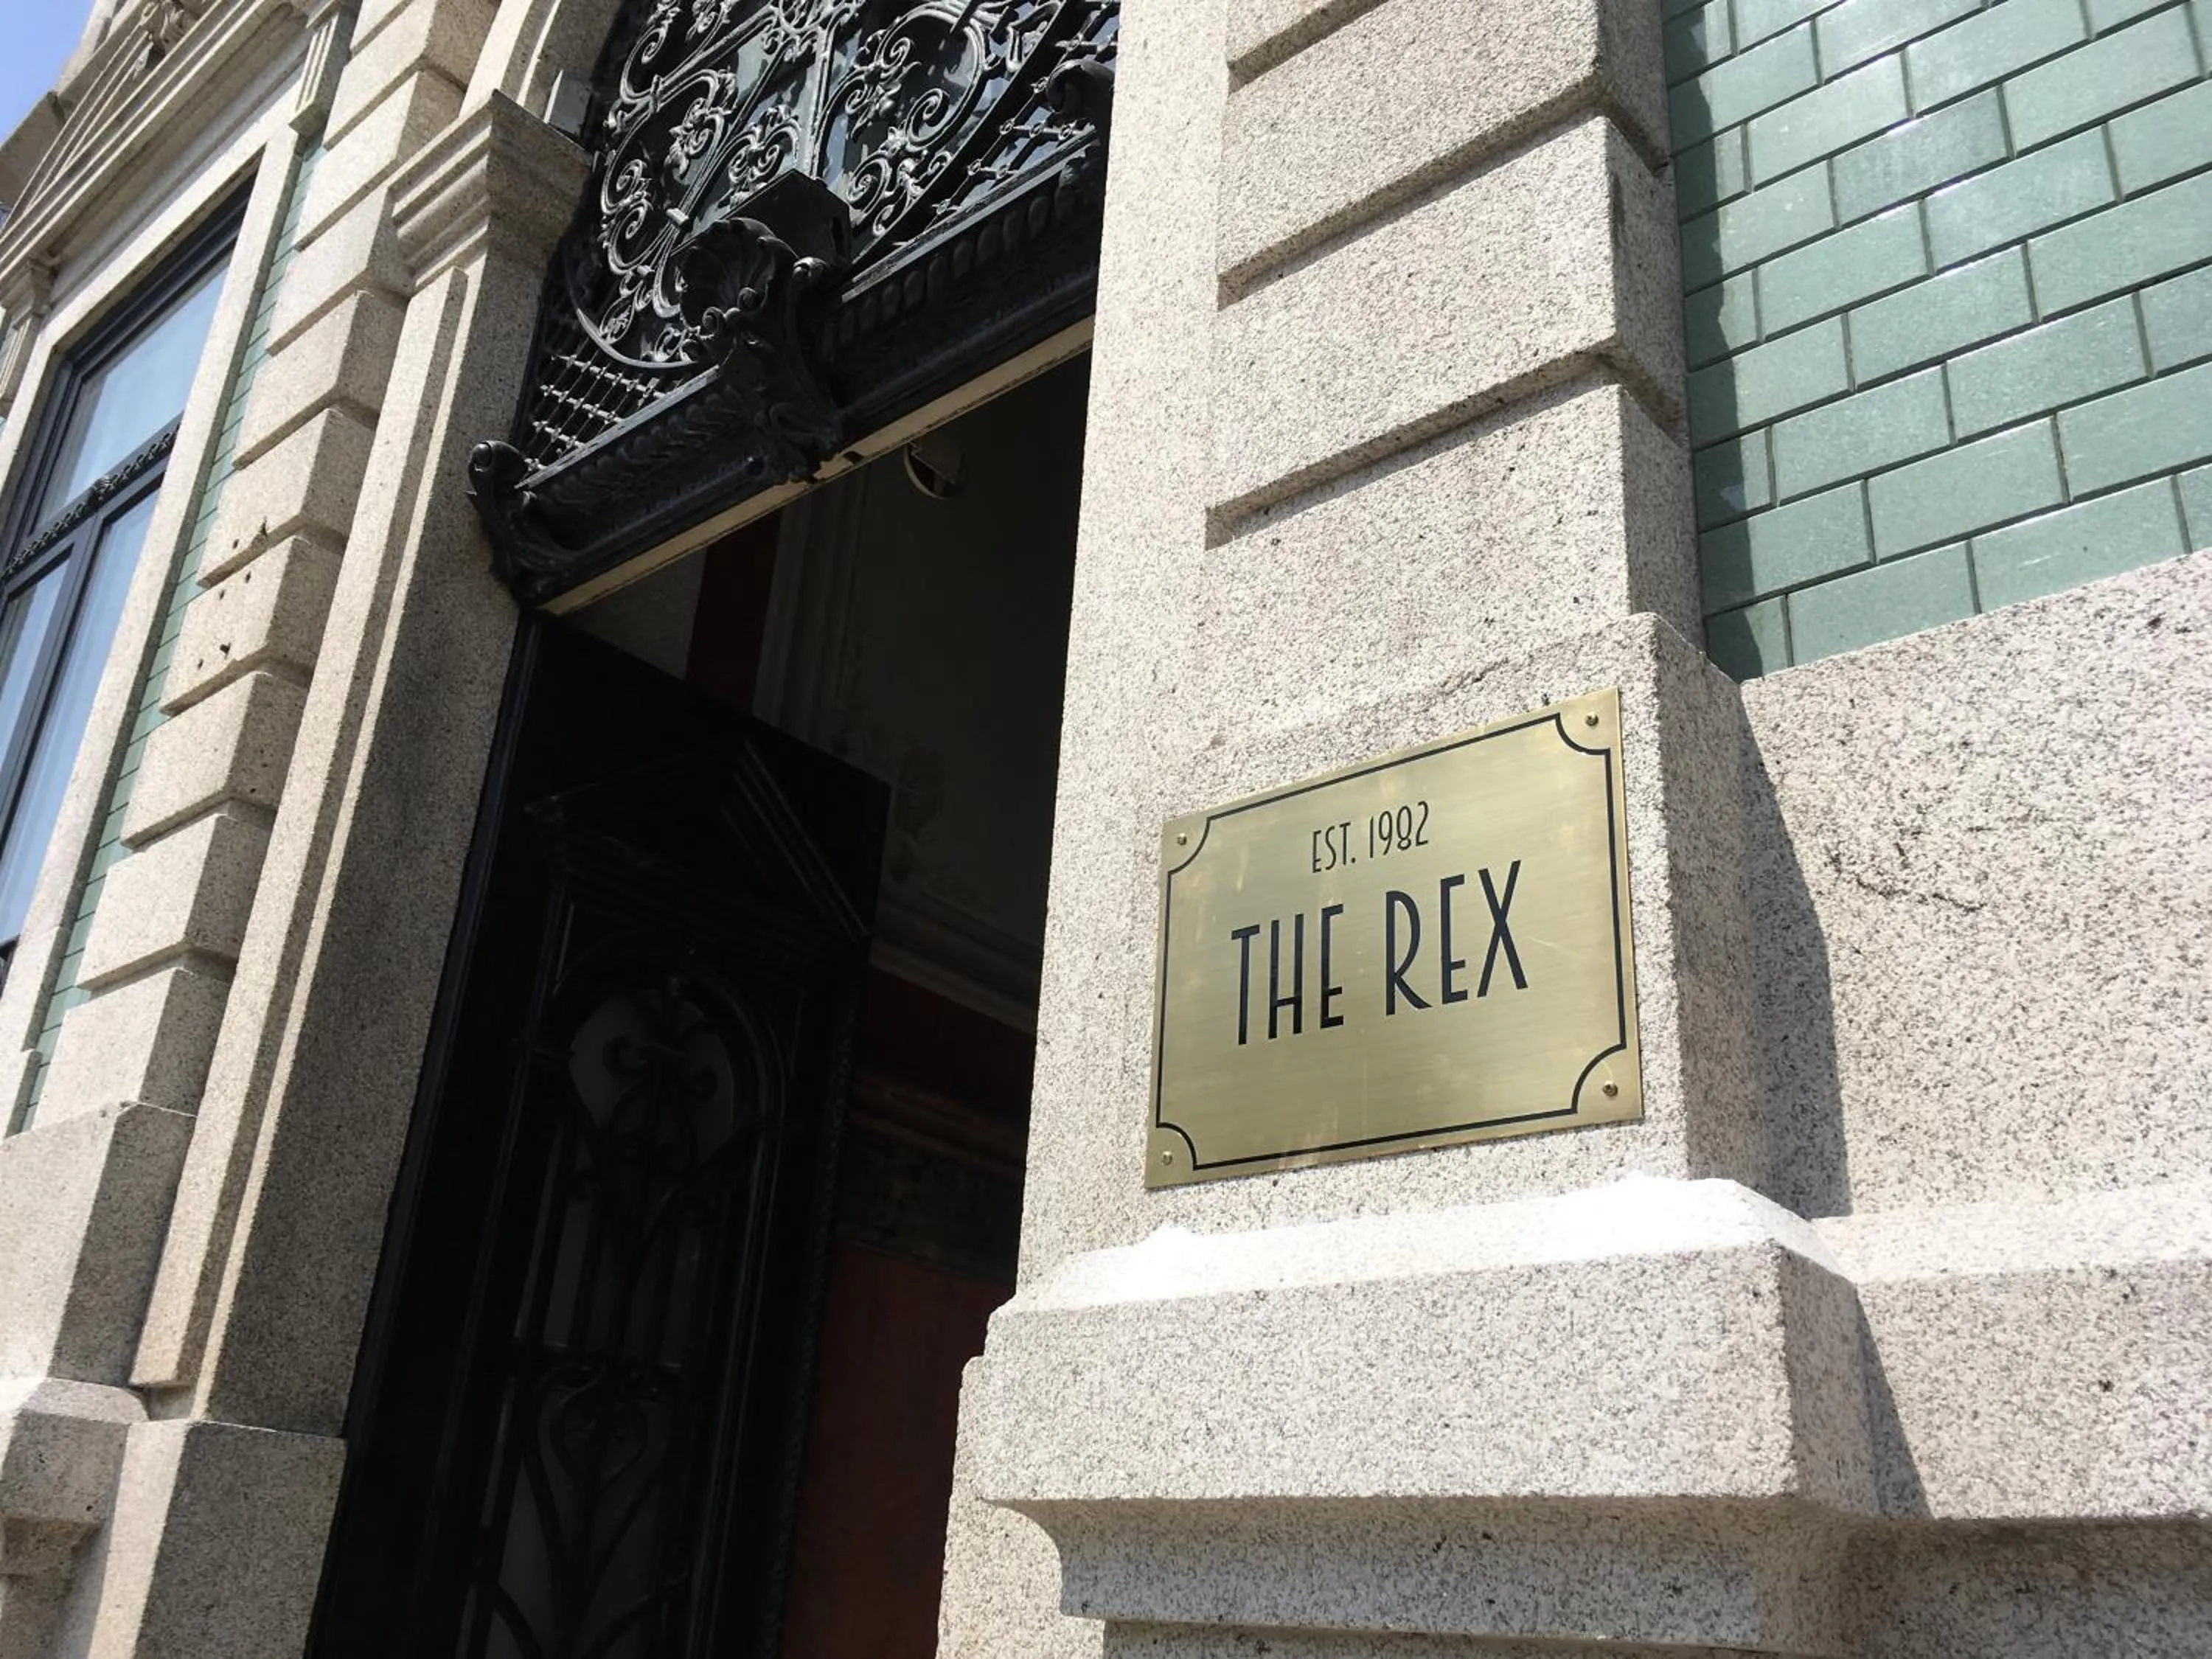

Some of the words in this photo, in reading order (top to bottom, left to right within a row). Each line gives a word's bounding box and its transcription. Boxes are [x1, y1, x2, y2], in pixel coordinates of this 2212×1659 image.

[1312, 822, 1356, 873] EST.
[1369, 801, 1429, 858] 1982
[1231, 904, 1344, 1046] THE
[1385, 860, 1528, 1015] REX
